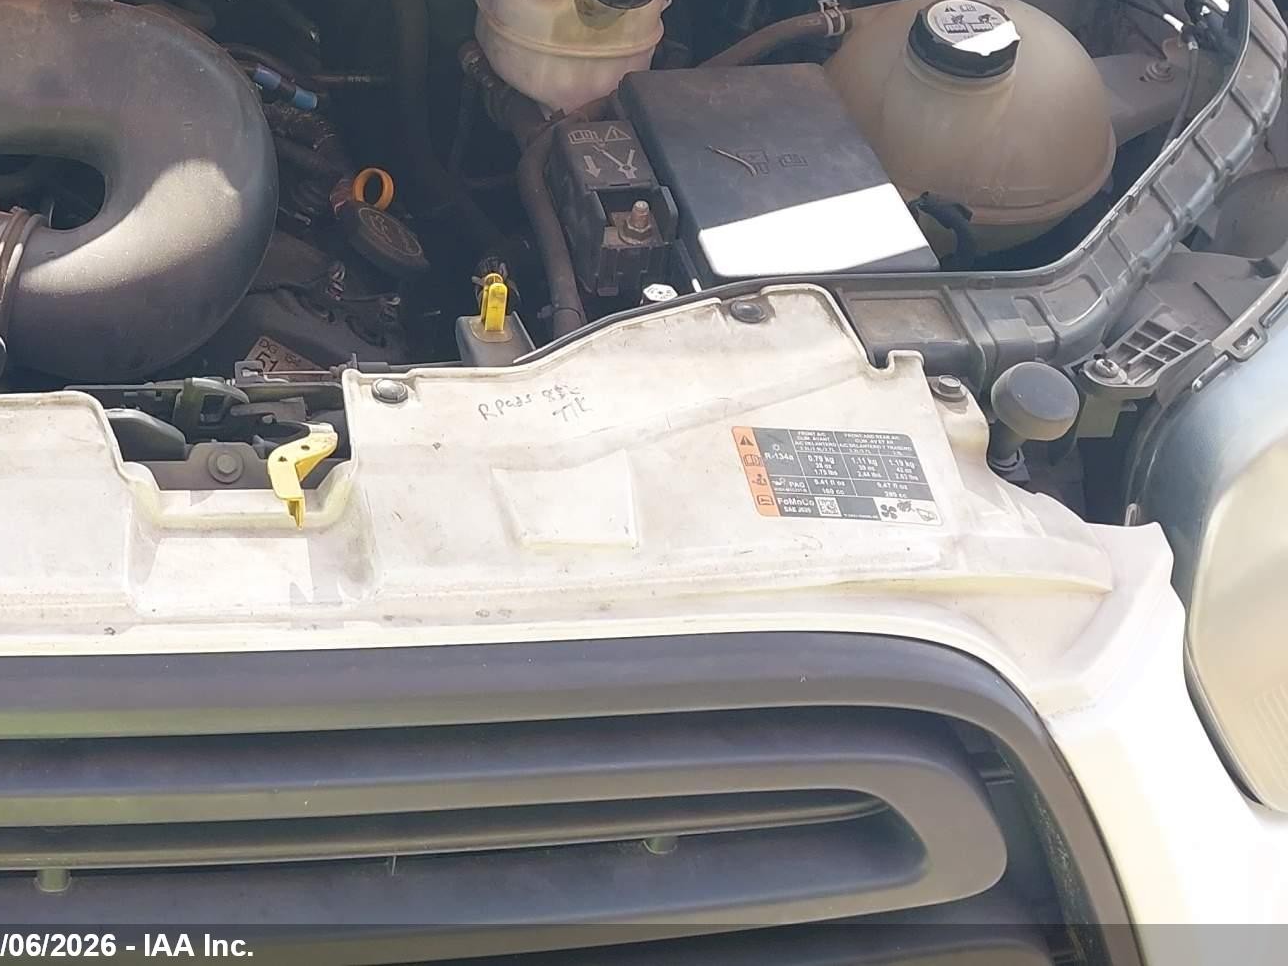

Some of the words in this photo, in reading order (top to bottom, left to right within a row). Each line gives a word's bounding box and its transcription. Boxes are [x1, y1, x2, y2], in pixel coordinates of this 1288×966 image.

[764, 453, 794, 461] R-134a
[824, 455, 835, 464] kg
[867, 458, 878, 466] kg
[904, 460, 915, 469] kg
[777, 497, 814, 506] FoMoCo
